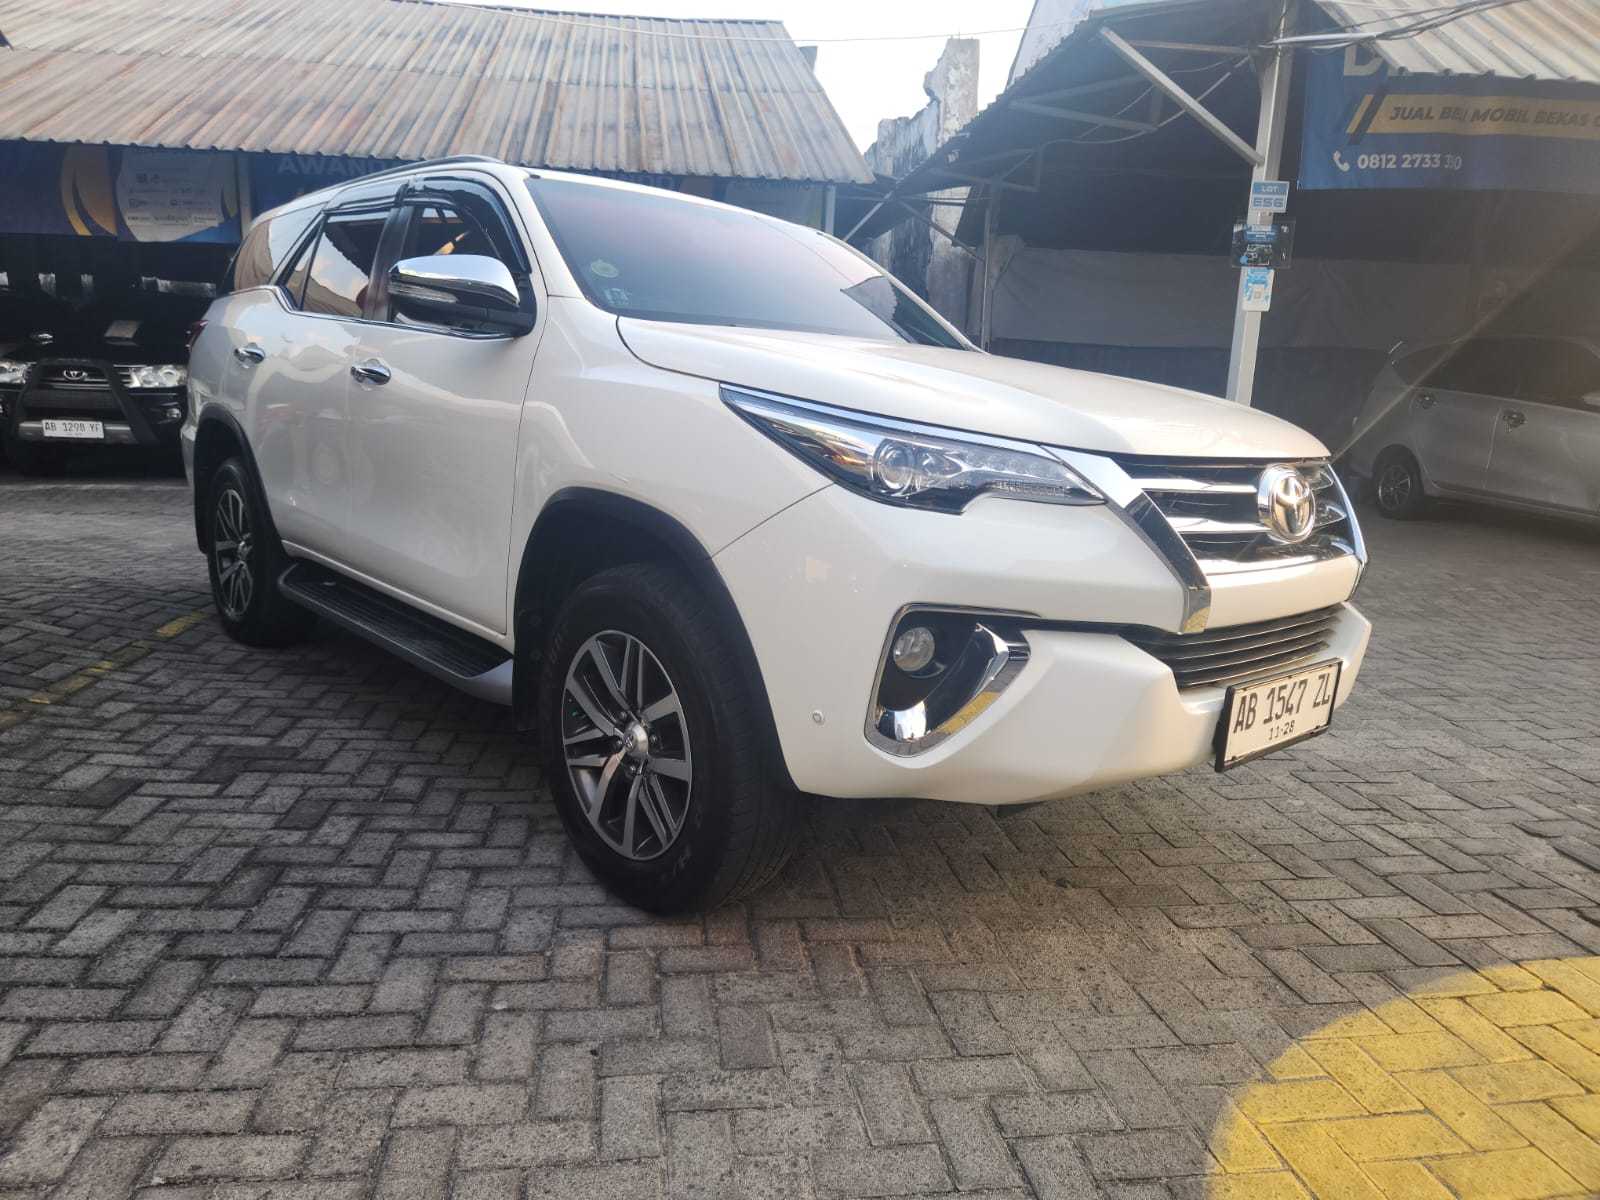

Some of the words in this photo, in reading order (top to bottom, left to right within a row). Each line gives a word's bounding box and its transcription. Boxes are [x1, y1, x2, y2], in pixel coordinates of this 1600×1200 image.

[1389, 106, 1434, 121] JUAL
[1470, 108, 1529, 123] MOBIL
[1533, 110, 1590, 127] BEKAS
[1357, 153, 1397, 169] 0812
[1401, 153, 1440, 169] 2733
[1261, 185, 1278, 193] LOT
[45, 422, 57, 431] AB
[1233, 692, 1258, 734] AB
[1263, 678, 1308, 725] 1547
[1312, 672, 1332, 709] ZL
